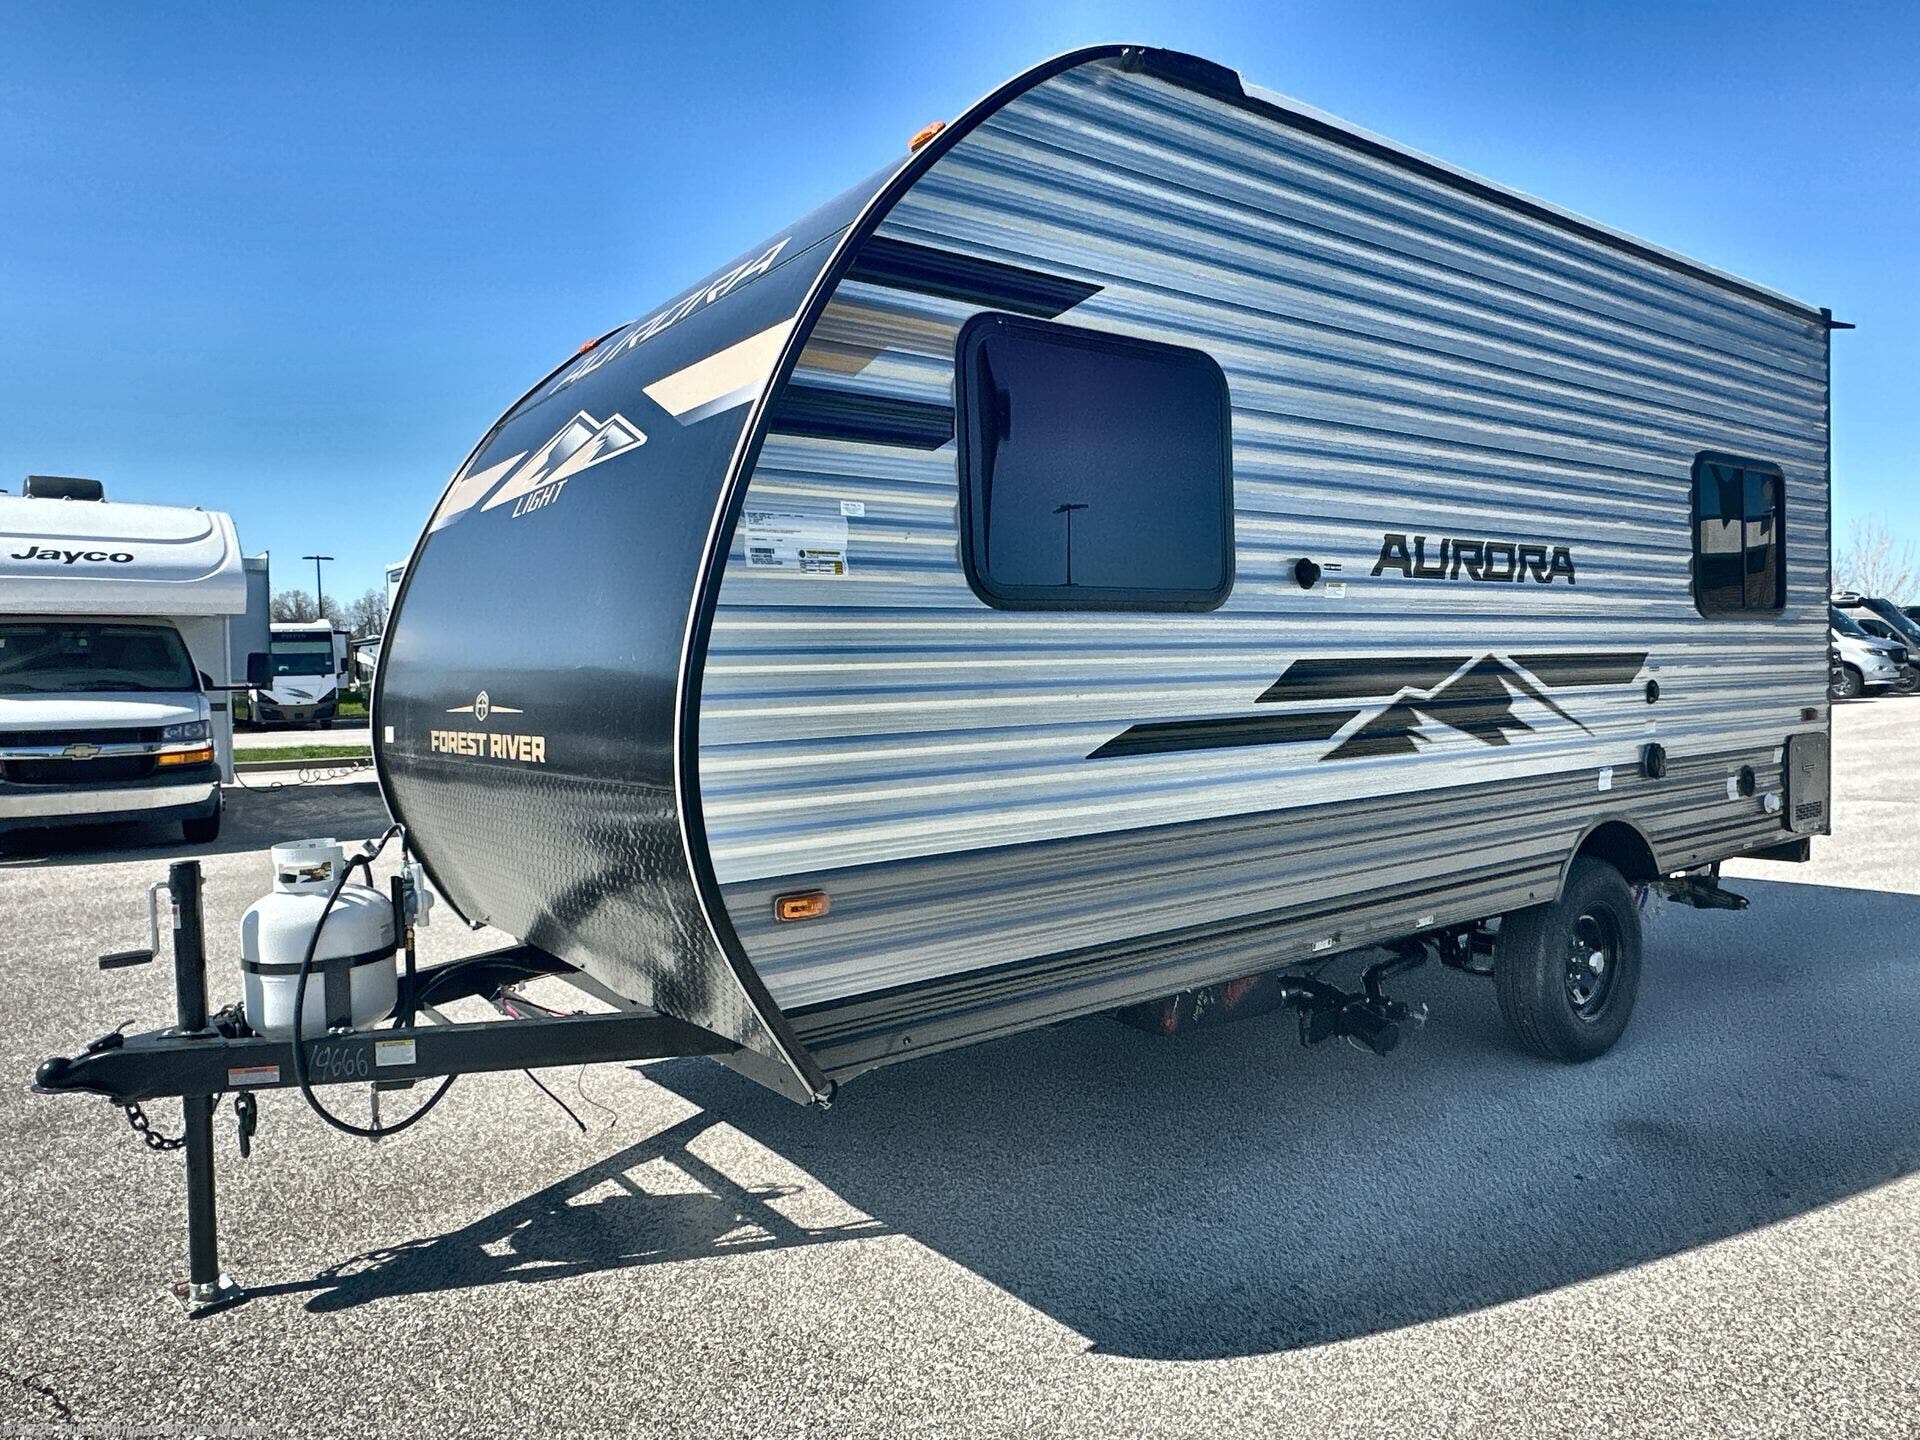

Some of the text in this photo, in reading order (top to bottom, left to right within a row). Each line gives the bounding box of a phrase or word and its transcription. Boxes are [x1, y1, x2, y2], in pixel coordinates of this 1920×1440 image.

[511, 478, 569, 519] LIGHT
[11, 546, 134, 564] Jayco
[1370, 533, 1576, 585] AURORA
[430, 730, 546, 764] FOREST RIVER
